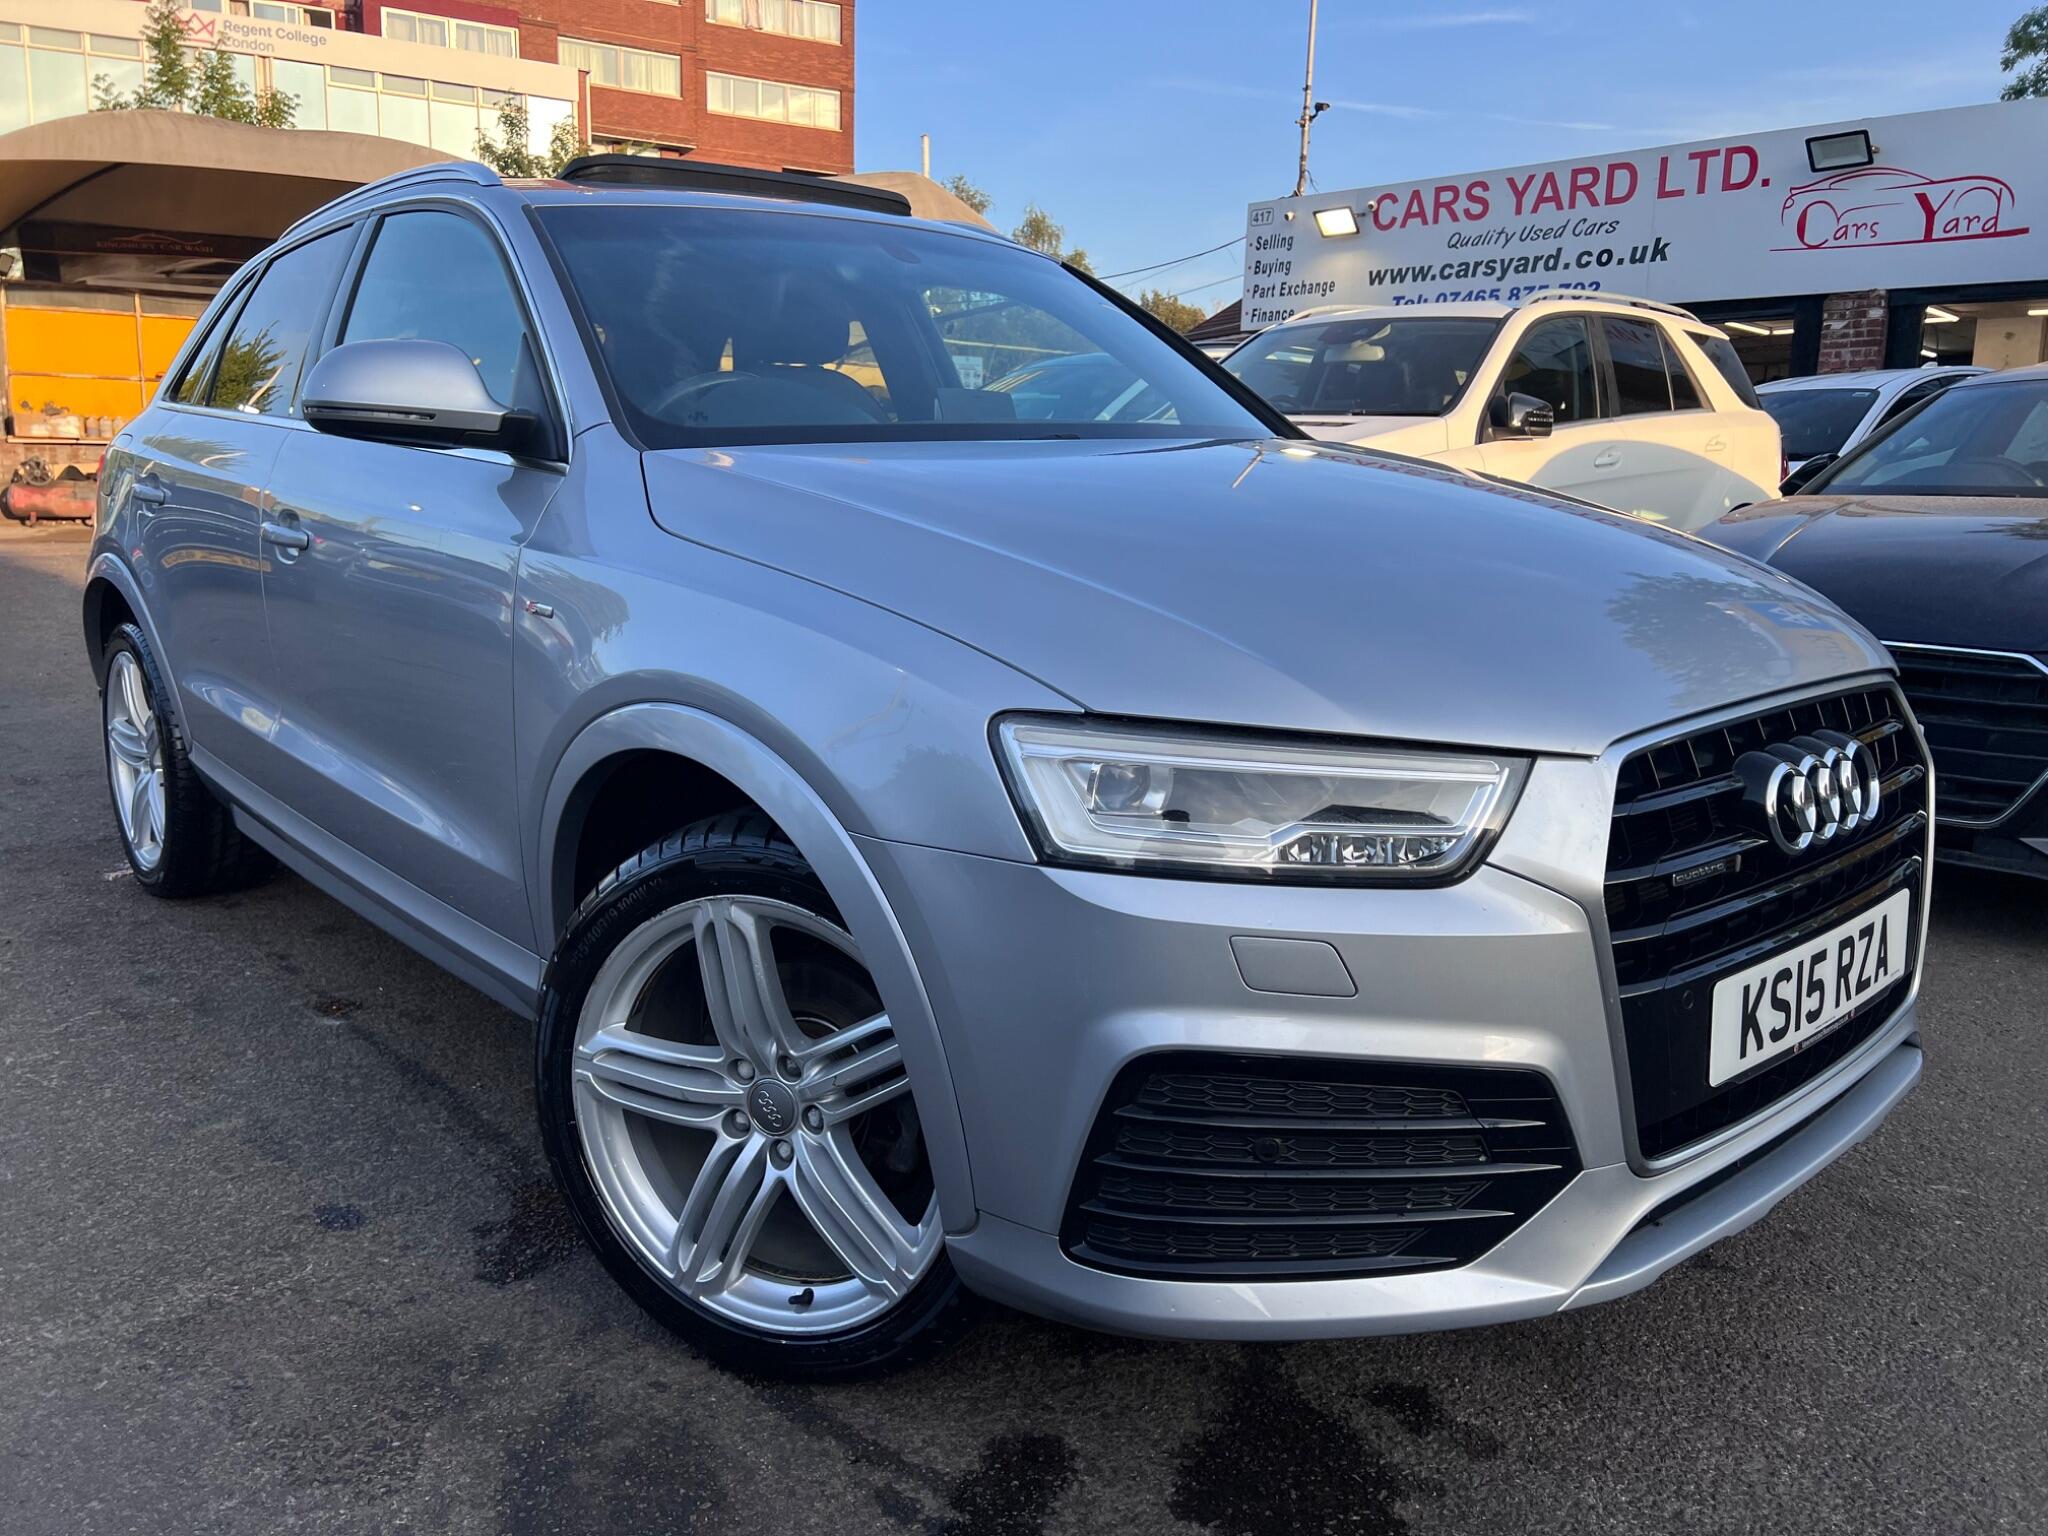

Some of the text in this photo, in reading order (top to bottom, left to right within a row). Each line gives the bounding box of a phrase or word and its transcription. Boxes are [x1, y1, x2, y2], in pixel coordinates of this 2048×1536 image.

[223, 20, 328, 47] Regent College
[222, 35, 275, 53] London
[1372, 144, 1771, 231] CARS YARD LTD.
[1252, 210, 1272, 224] 417
[1796, 186, 2003, 249] Cars Yard
[1255, 235, 1294, 251] Selling
[1447, 217, 1620, 249] Quality Used Cars
[1254, 258, 1292, 278] Buying
[1368, 236, 1671, 287] www.carsyard.co.uk
[1252, 279, 1336, 299] Part Exchange
[1435, 288, 1501, 303] 07465
[1250, 307, 1295, 323] Finance
[1739, 912, 1890, 1060] KS15 RZA
